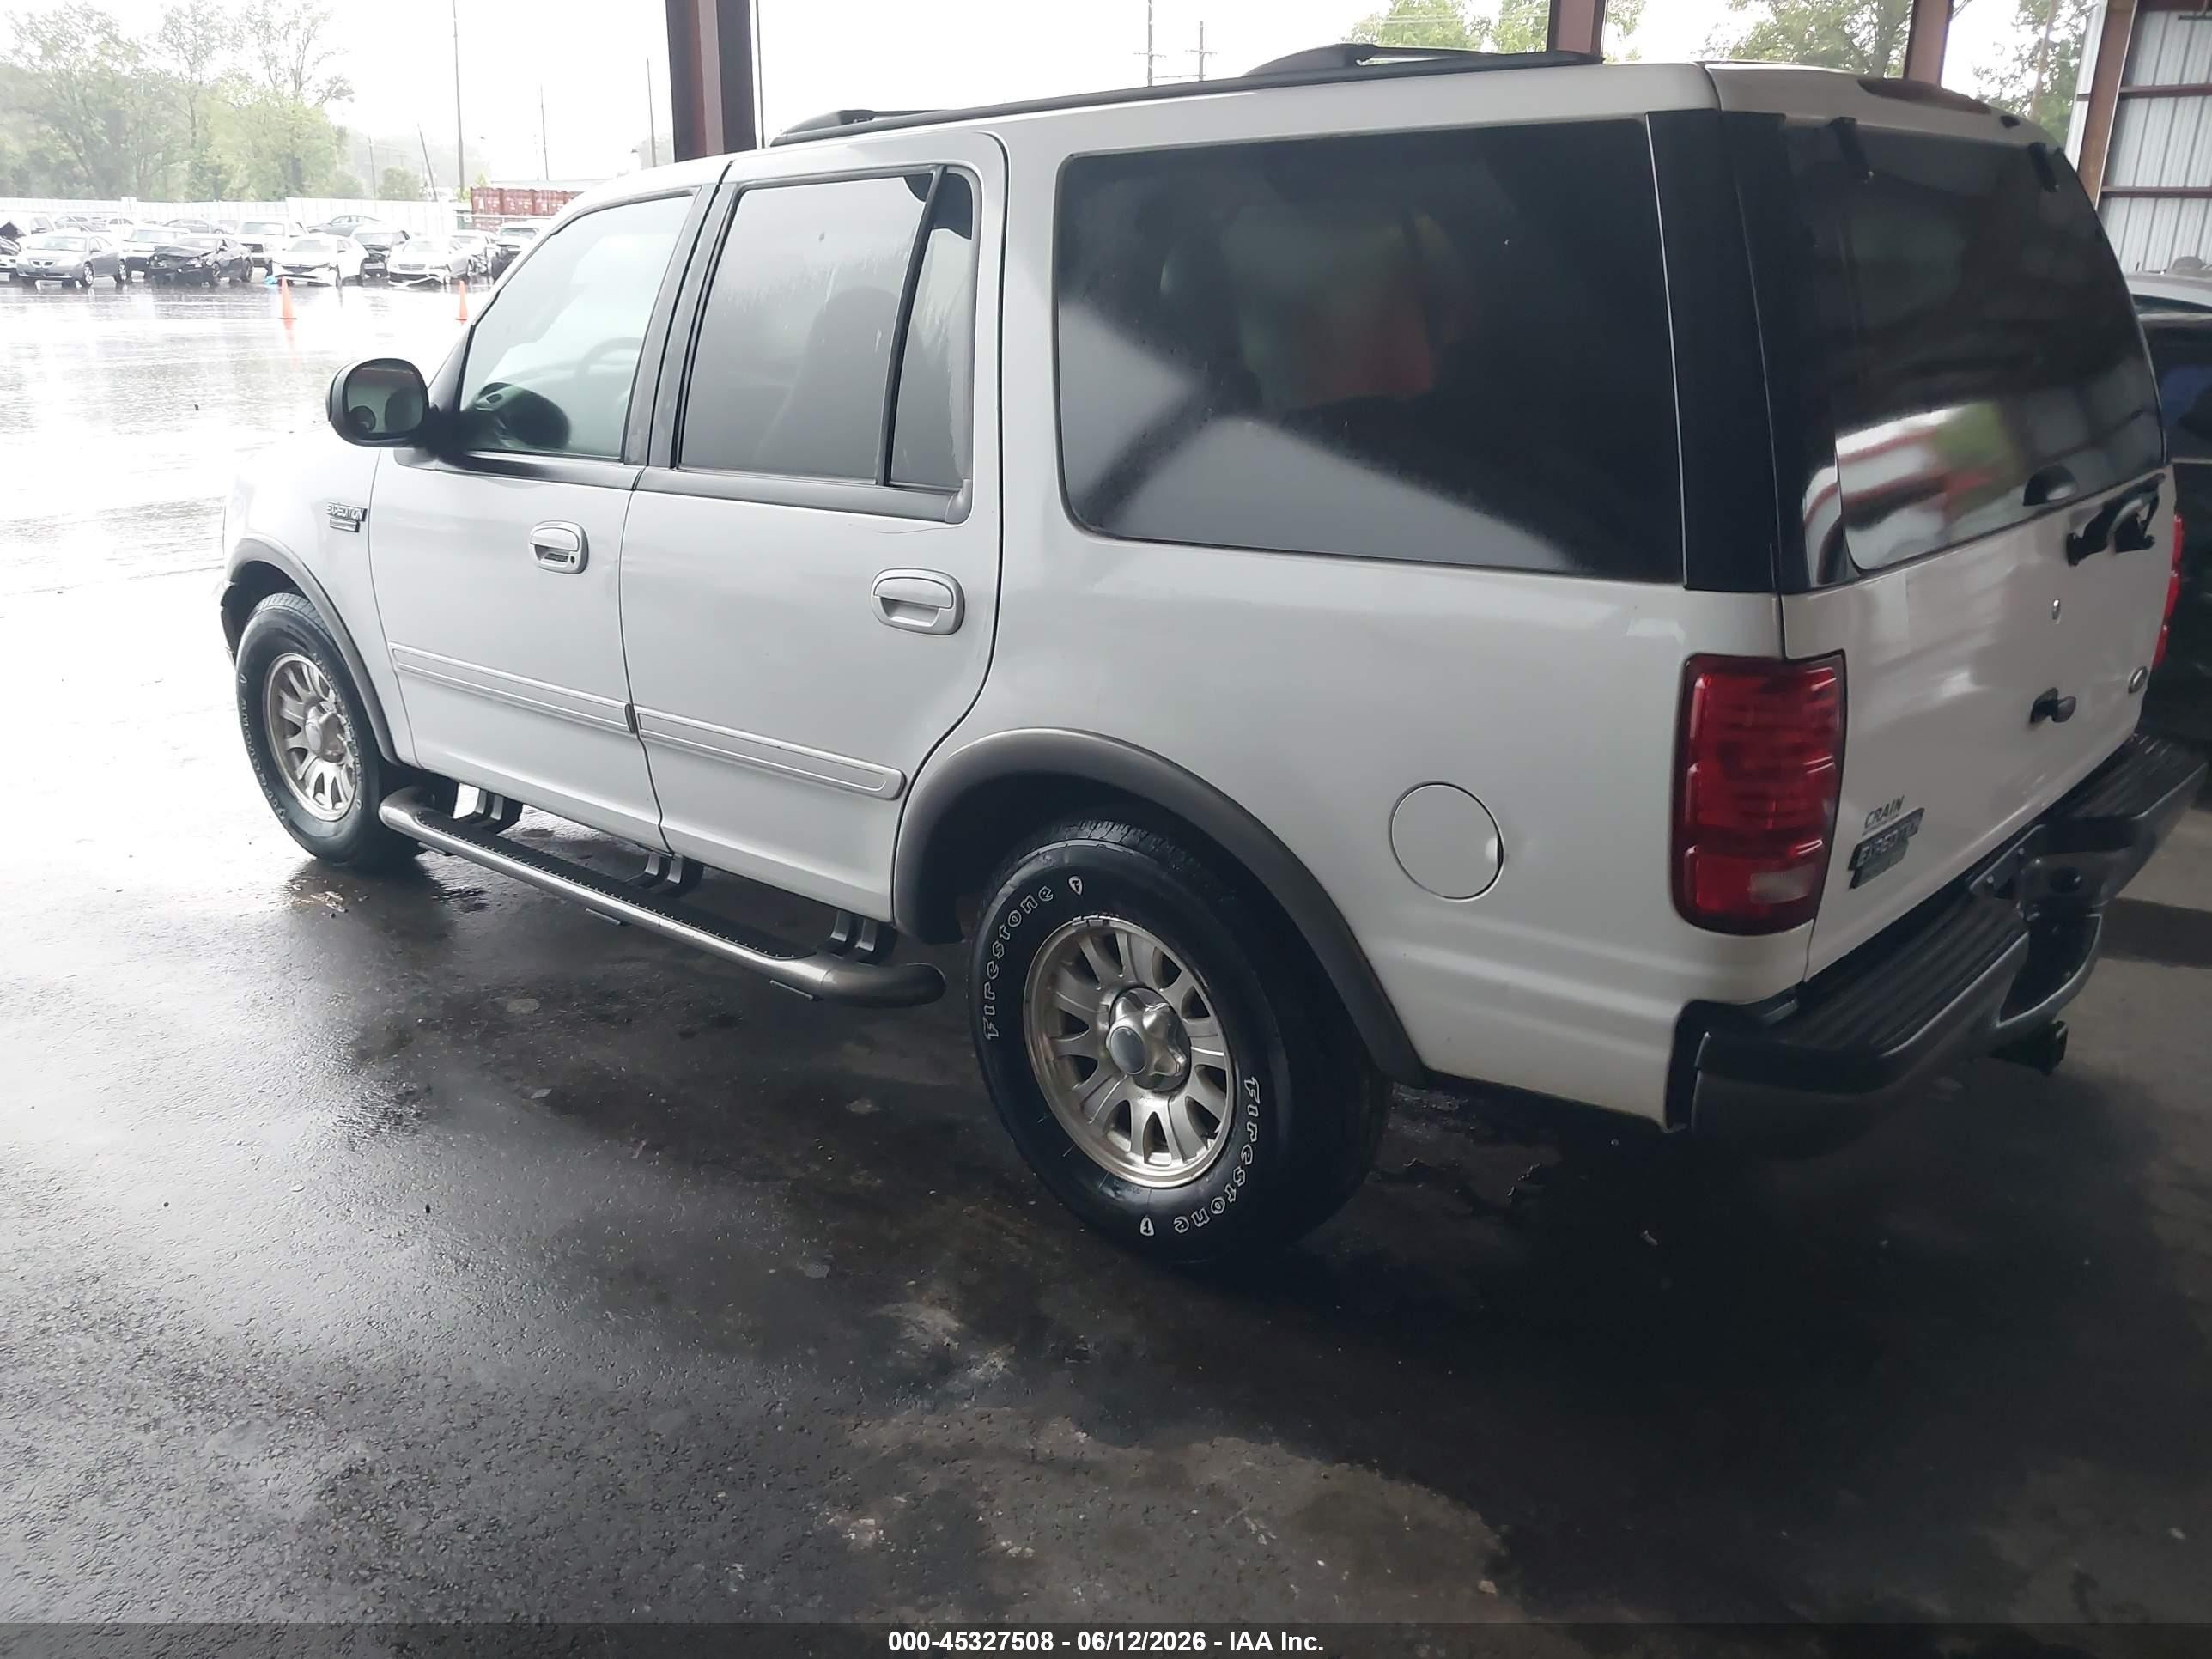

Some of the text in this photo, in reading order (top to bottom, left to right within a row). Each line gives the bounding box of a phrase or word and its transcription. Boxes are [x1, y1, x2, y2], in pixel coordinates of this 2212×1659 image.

[1864, 794, 1905, 830] CRAIN
[982, 885, 1054, 1041] Firestone
[1173, 1077, 1261, 1234] Firestone
